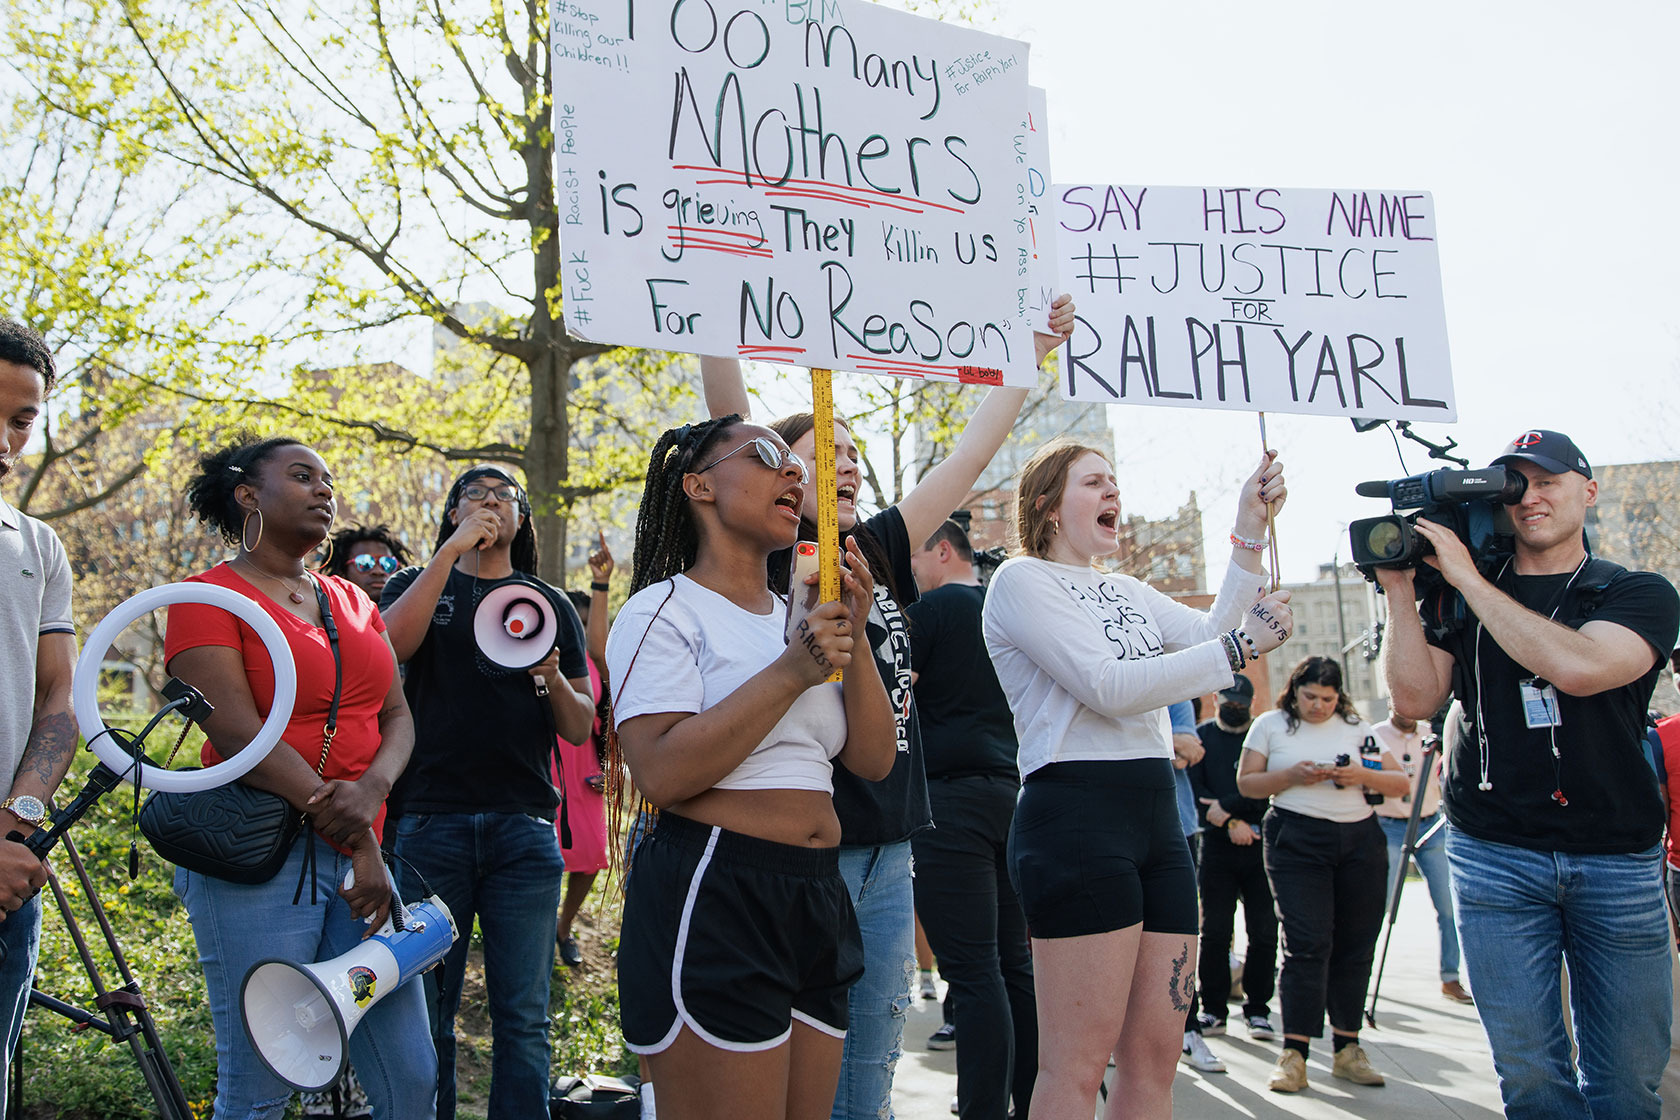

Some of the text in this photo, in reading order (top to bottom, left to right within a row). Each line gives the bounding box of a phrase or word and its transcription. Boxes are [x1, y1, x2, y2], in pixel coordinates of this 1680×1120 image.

[972, 66, 1000, 86] Ralph
[669, 66, 982, 205] Mothers
[1016, 183, 1025, 205] on
[1060, 185, 1433, 241] SAY HIS NAME
[660, 188, 765, 263] grieving
[769, 204, 855, 257] They
[1071, 243, 1407, 299] #JUSTICE
[646, 279, 702, 335] For
[1232, 302, 1273, 321] FOR
[1066, 314, 1449, 410] RALPH YARL
[1250, 603, 1288, 641] RACISTS
